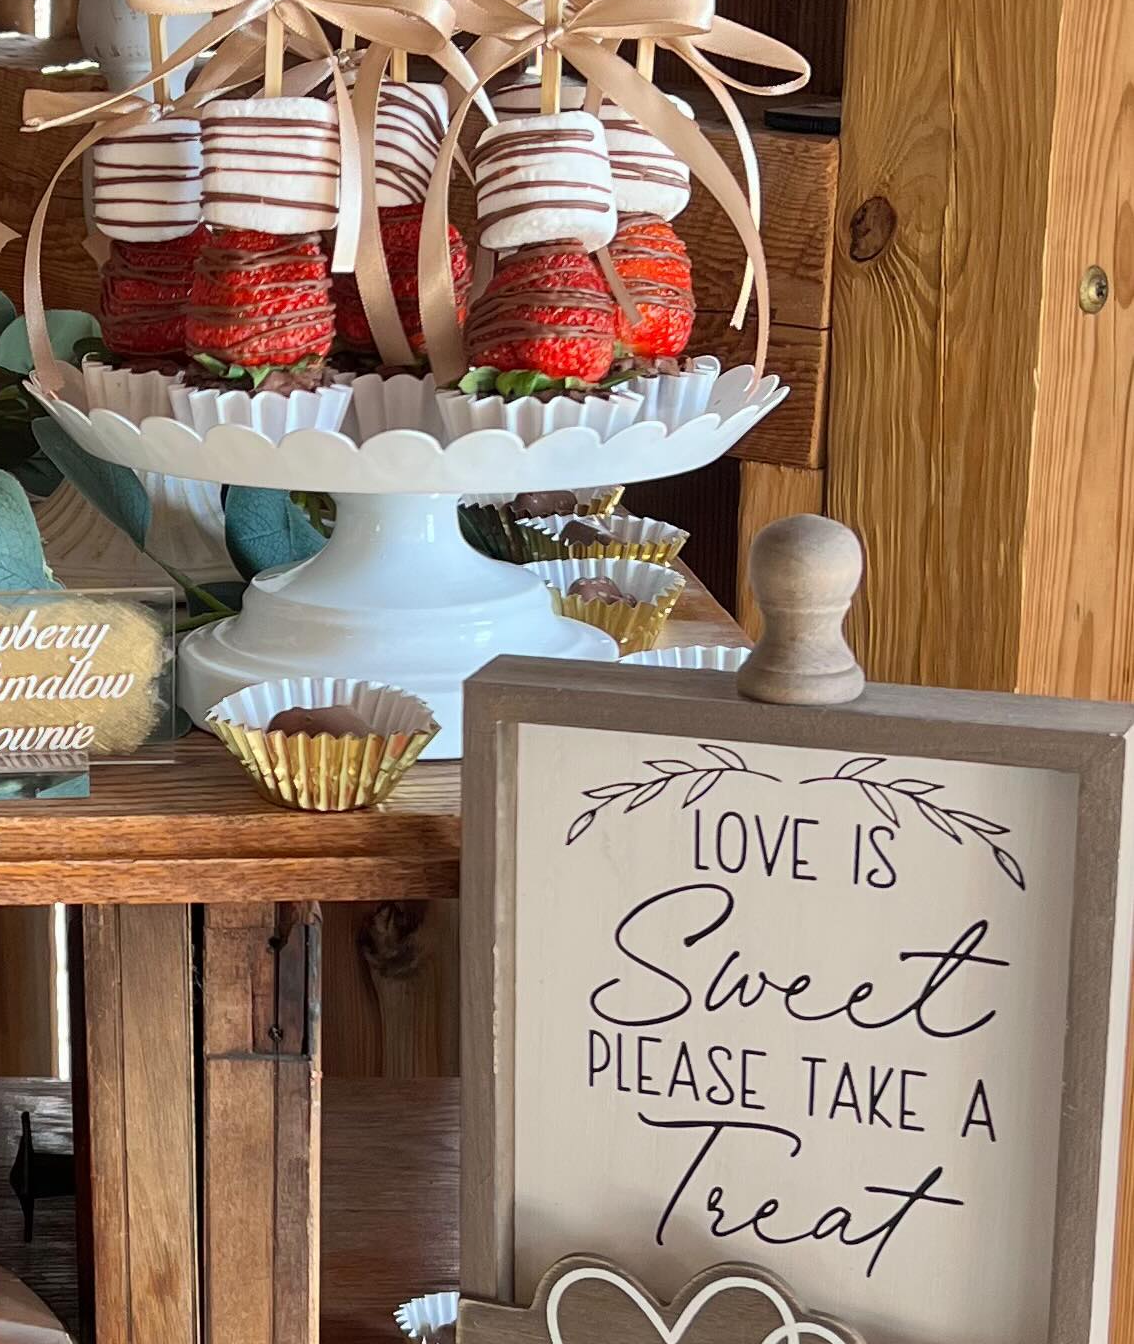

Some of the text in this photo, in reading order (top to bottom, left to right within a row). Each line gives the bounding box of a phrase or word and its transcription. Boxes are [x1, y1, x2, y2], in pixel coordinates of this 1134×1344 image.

[693, 809, 897, 890] LOVE IS
[589, 882, 1010, 1039] Sweet
[588, 1030, 997, 1143] PLEASE TAKE A
[637, 1111, 965, 1279] Treat
